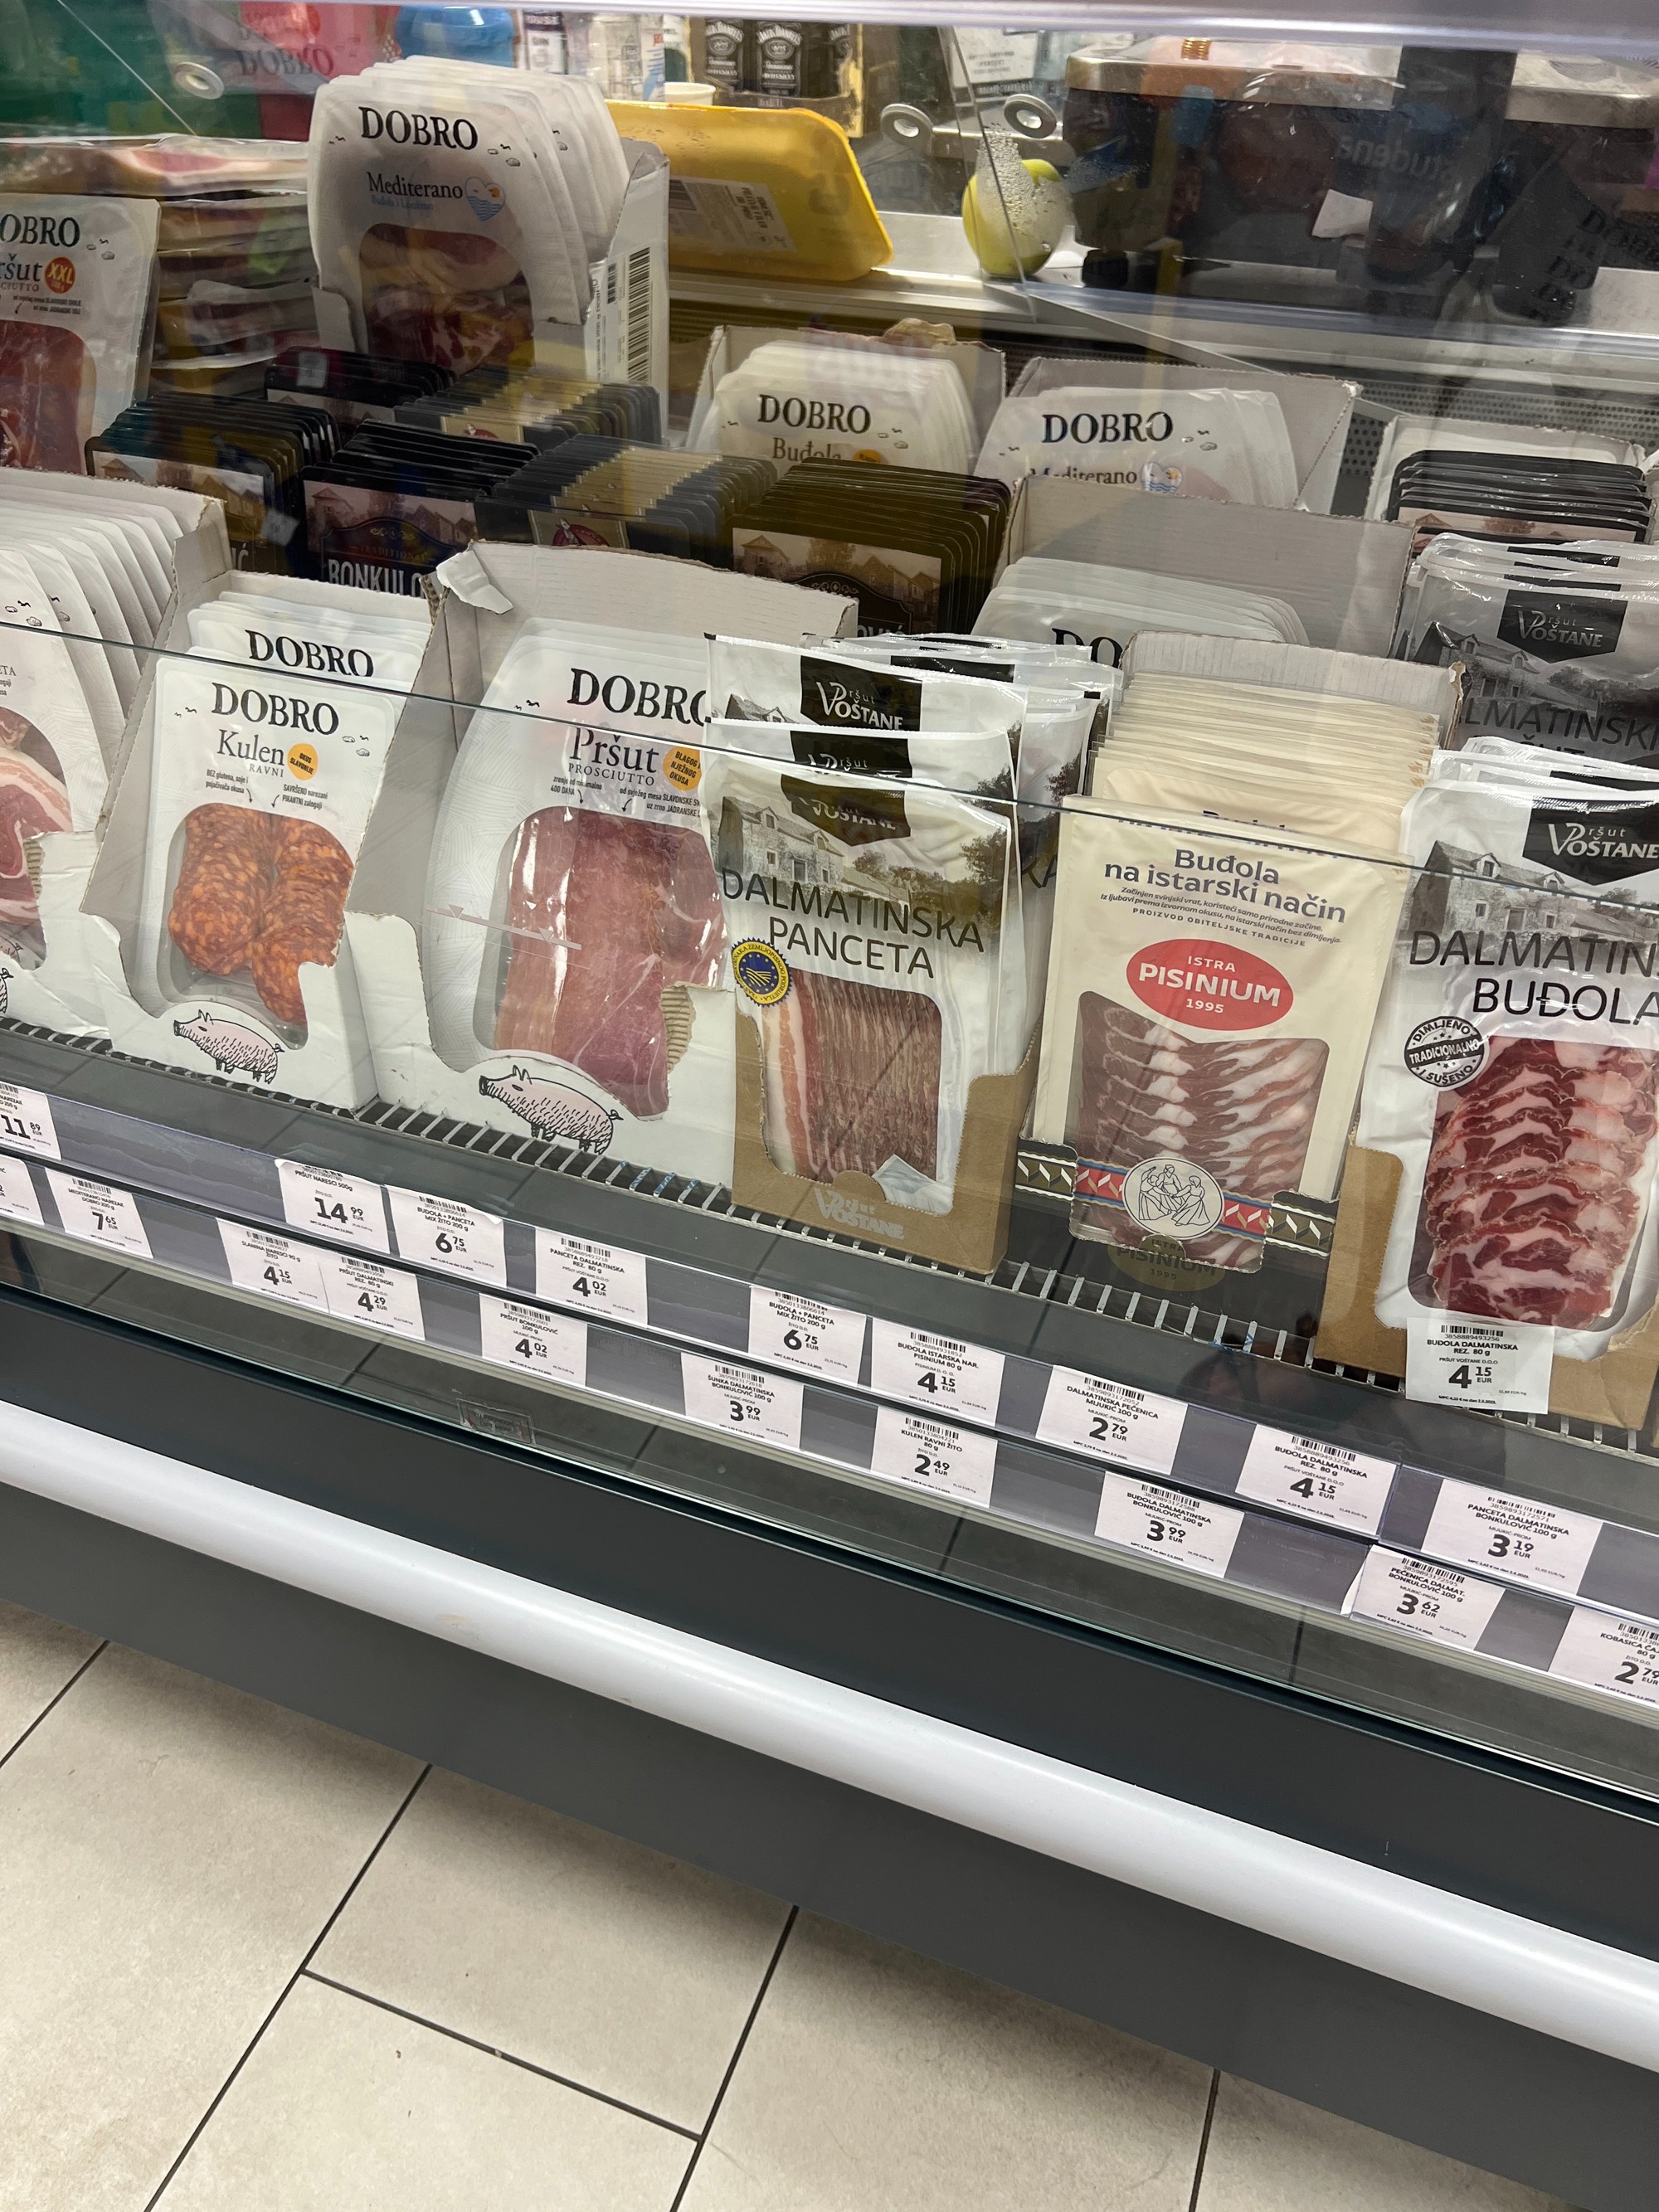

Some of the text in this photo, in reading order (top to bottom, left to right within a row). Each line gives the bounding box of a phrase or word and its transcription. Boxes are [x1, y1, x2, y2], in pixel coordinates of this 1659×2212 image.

[358, 107, 479, 150] DOBRO
[366, 172, 464, 199] Mediterano
[0, 213, 80, 247] OBRO
[48, 262, 73, 284] XXL
[757, 393, 871, 435] DOBRO
[1041, 411, 1174, 444] DOBRO
[245, 630, 375, 678] DOBRO
[212, 682, 340, 736] DOBRO
[1458, 697, 1659, 752] LMATINSKI
[216, 729, 285, 766] Kulen
[570, 727, 659, 773] Pršut
[675, 751, 698, 766] BLAGOG
[249, 763, 285, 778] RAVNI
[568, 763, 654, 786] PROSCIUTTO
[669, 772, 689, 786] OKUSA
[670, 761, 697, 778] NJEŽNOG
[648, 792, 662, 801] mesa
[1548, 823, 1659, 859] VOŠTANE
[1174, 848, 1280, 885] Buđola
[1104, 863, 1346, 924] na istarski način
[722, 868, 985, 953] DALMATINSKA
[1108, 894, 1135, 903] ljubavi
[1134, 897, 1160, 907] prema
[1160, 902, 1198, 914] izvornom
[1198, 908, 1224, 920] okusu,
[1224, 913, 1236, 921] na
[1235, 914, 1266, 929] istarski
[1265, 923, 1287, 934] način
[1287, 929, 1303, 937] bez
[1303, 931, 1343, 945] dimljenja.
[1121, 887, 1324, 932] Začinjen svinjski vrat, koristeći samo prirodne začine.
[1132, 907, 1306, 947] PROIZVOD OBITELJSKE TRADICIJE
[770, 916, 934, 979] PANCETA
[1409, 931, 1657, 978] DALMATIN
[1187, 955, 1237, 973] ISTRA
[1138, 963, 1282, 1008] PISINIUM
[1185, 999, 1225, 1014] 1995
[1472, 978, 1659, 1025] BUĐOLA
[1413, 1019, 1471, 1043] DIMLJENO
[1408, 1038, 1479, 1064] TRADICIONALNO
[1426, 1065, 1473, 1085] SUŠENO
[1, 1115, 31, 1140] 11
[30, 1121, 41, 1131] 89
[92, 1211, 117, 1231] 7 65
[314, 1197, 363, 1224] 14 99
[435, 1232, 465, 1254] 6 75
[550, 1248, 625, 1274] PANCETA DALMATINSKA
[264, 1266, 290, 1286] 4 15
[572, 1276, 607, 1297] 4 02
[1150, 1268, 1177, 1280] 1995
[358, 1292, 386, 1312] 4 29
[776, 1310, 820, 1328] MIX ŽITO 200
[804, 1312, 834, 1325] PANCETA
[515, 1338, 547, 1359] 4 02
[783, 1329, 818, 1350] 6 75
[1462, 1341, 1519, 1351] DALMATINSKA
[913, 1353, 946, 1367] PISINIUM
[928, 1349, 980, 1369] ISTARSKA NAR.
[730, 1380, 775, 1398] DALMATINSKA
[917, 1372, 956, 1393] 4 15 EUR
[1448, 1364, 1472, 1389] 4
[1475, 1366, 1492, 1377] 15
[730, 1400, 761, 1422] 3 99
[1067, 1385, 1159, 1419] DALMATINSKA PEČENICA
[1086, 1398, 1132, 1417] MIJUKIĆ 100
[901, 1429, 963, 1452] KULEN RAVNI ŽITO
[1088, 1417, 1128, 1442] 2 79 EUR
[914, 1453, 951, 1477] 2 49 EUR
[1300, 1460, 1331, 1474] REZ. 80
[1310, 1455, 1368, 1479] DALMATINSKA
[1289, 1477, 1337, 1500] 4 15 EUR
[1132, 1500, 1197, 1525] BONKULOVIĆ 100
[1159, 1502, 1212, 1524] DALMATINSKA
[1467, 1503, 1569, 1536] PANCETA DALMATINSKA
[1475, 1512, 1550, 1537] BONKULOVIĆ 100
[1146, 1519, 1186, 1544] 3 99 EUR
[1487, 1534, 1535, 1559] 3 19 EUR
[1388, 1573, 1457, 1600] BONKULOVIĆ 100
[1390, 1567, 1466, 1597] PEČENICA DALMAT.
[1396, 1592, 1441, 1619] 3 62 EUR
[1600, 1631, 1642, 1650] KOBASICA
[1614, 1660, 1659, 1686] 2 79 EUR
